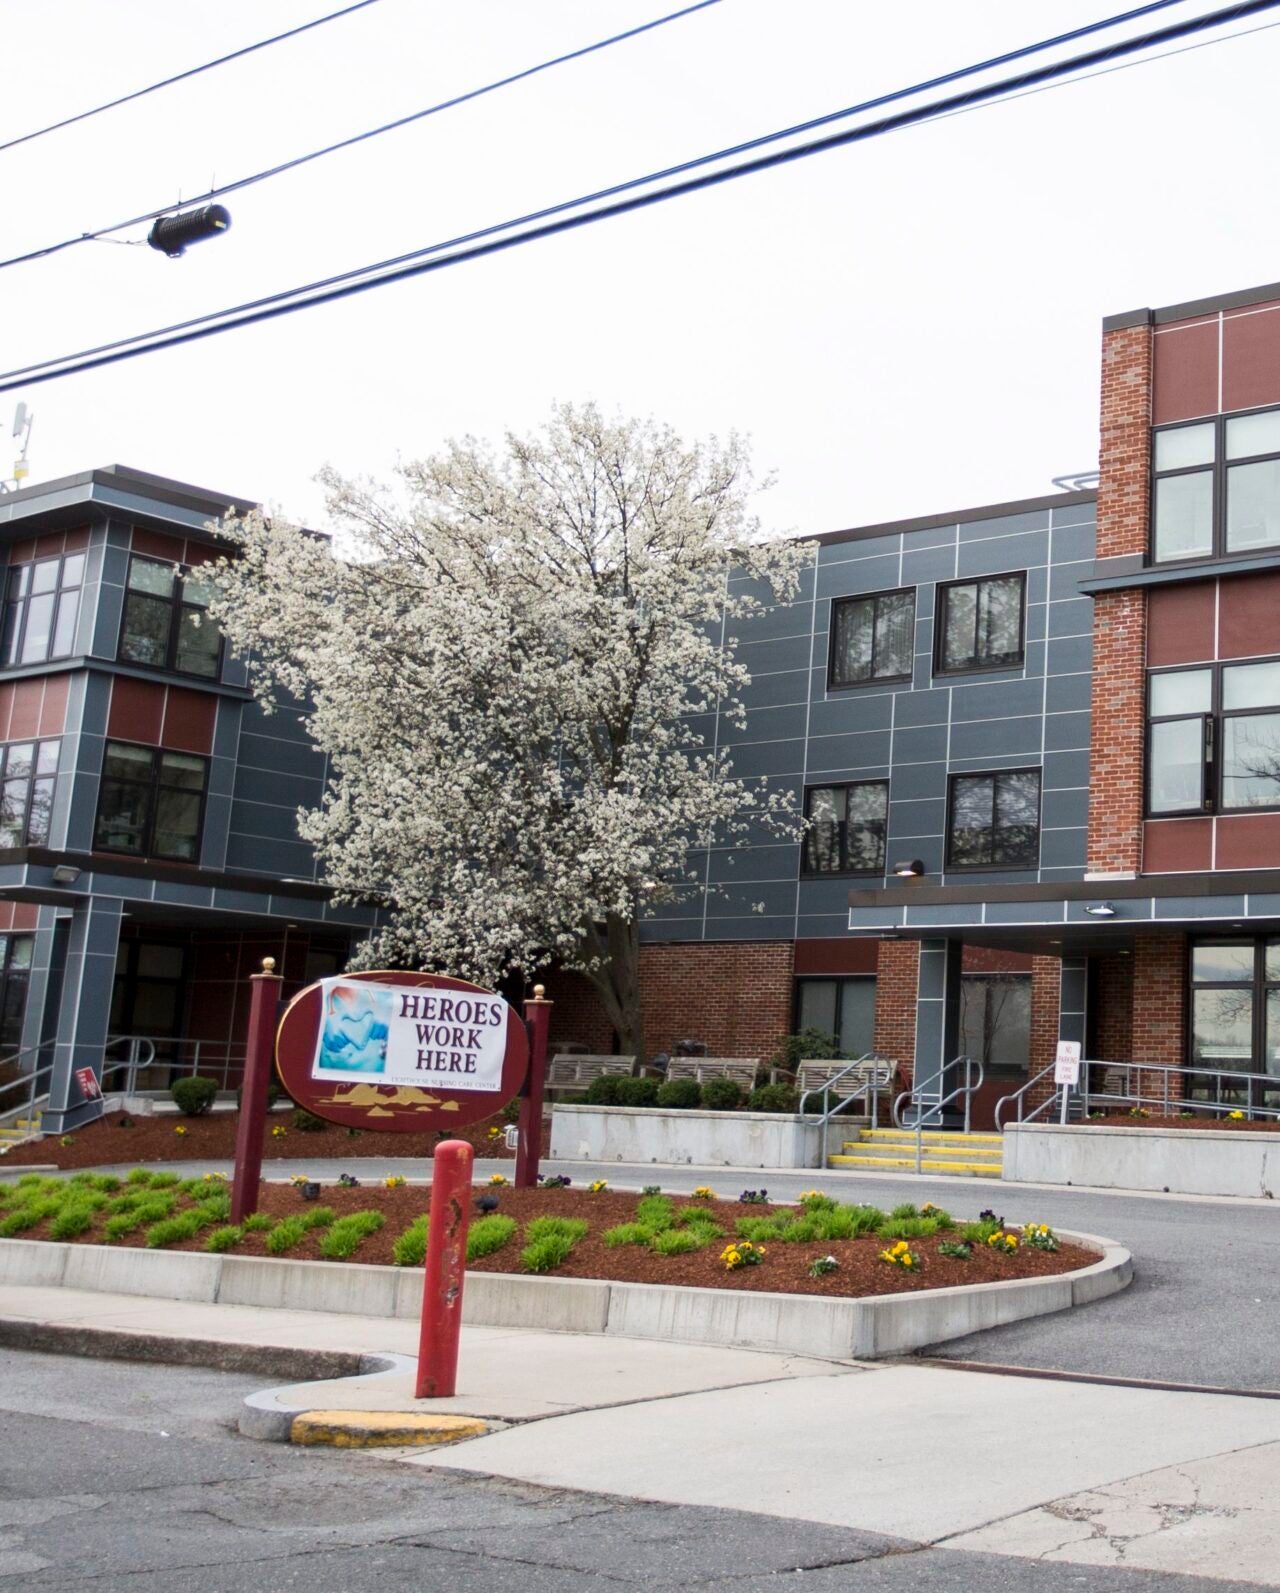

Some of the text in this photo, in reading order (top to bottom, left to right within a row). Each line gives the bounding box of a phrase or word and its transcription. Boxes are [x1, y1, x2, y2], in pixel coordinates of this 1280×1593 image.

[399, 994, 503, 1027] HEROES
[415, 1023, 483, 1050] WORK
[415, 1049, 478, 1074] HERE
[1058, 1055, 1078, 1065] PARKING
[458, 1080, 473, 1088] CARE
[475, 1081, 497, 1089] CENTER
